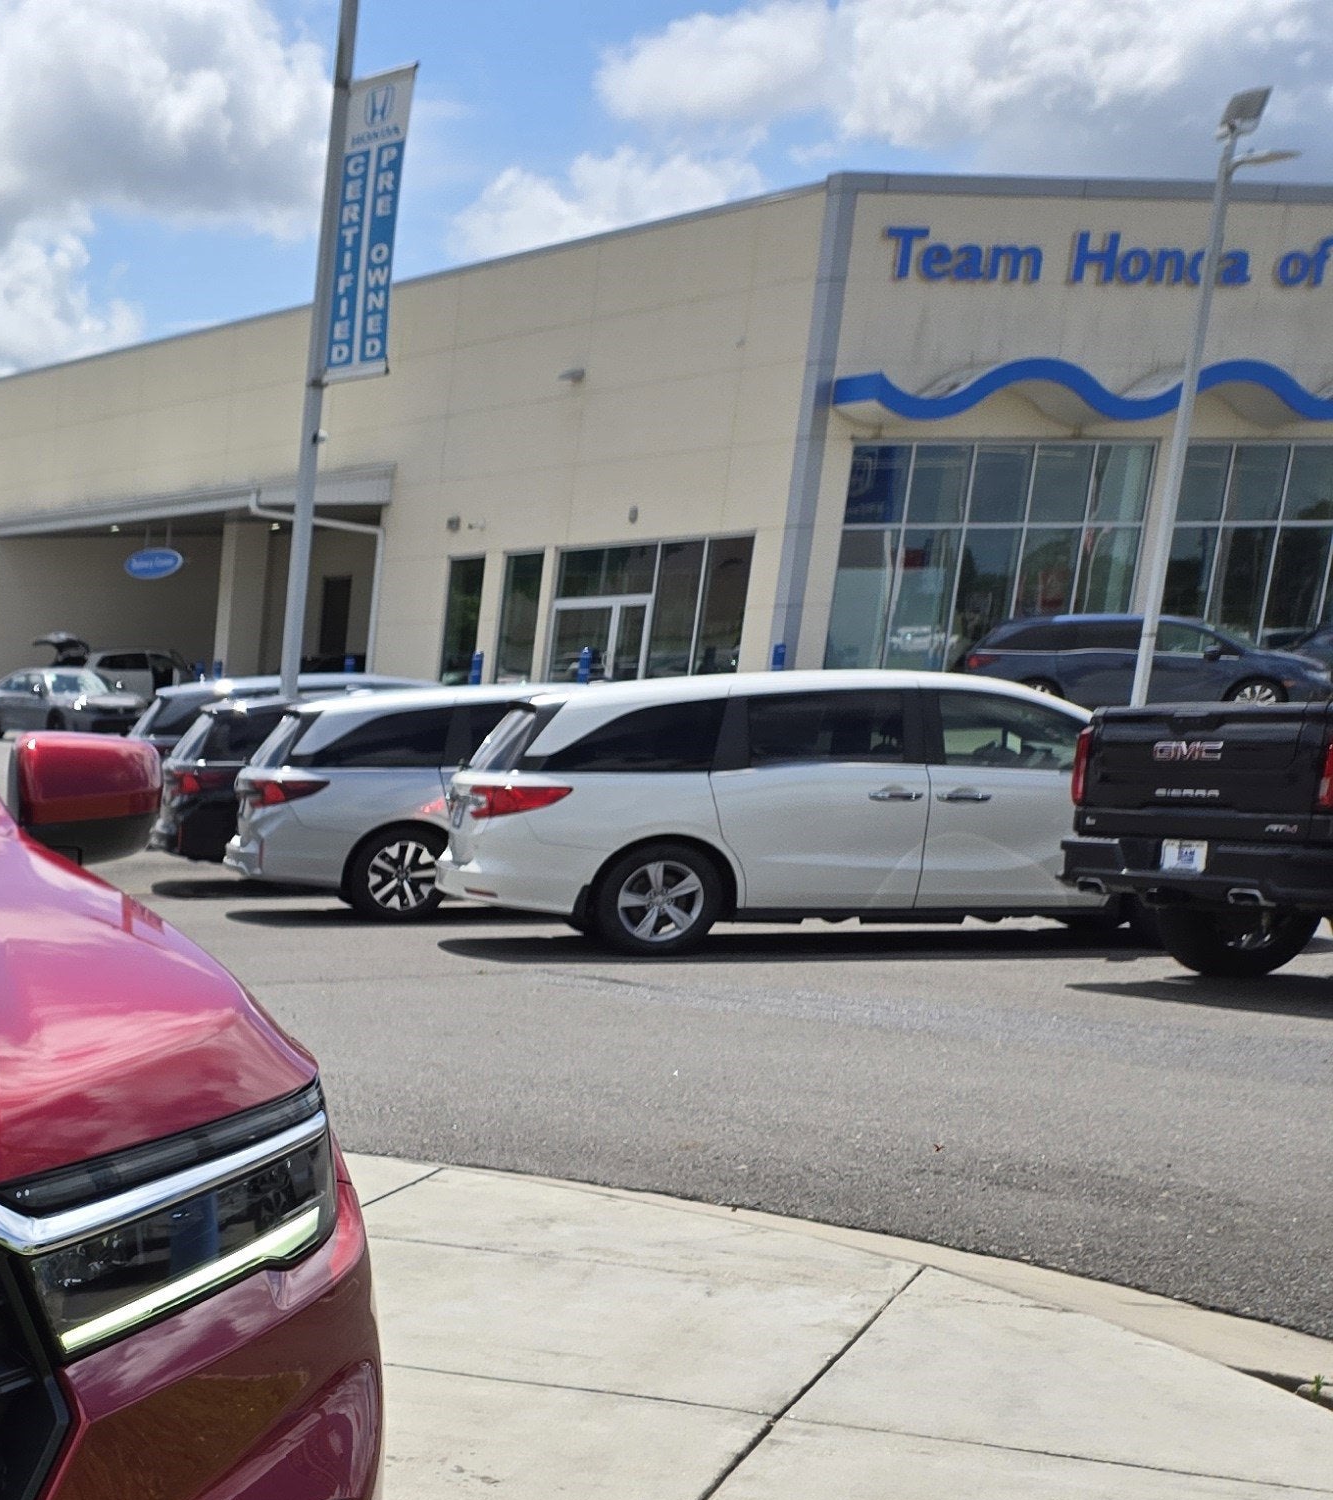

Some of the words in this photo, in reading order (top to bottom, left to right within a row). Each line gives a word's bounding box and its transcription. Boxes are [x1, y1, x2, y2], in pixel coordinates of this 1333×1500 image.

[375, 146, 397, 217] PRE
[330, 154, 367, 364] CERTIFIED
[885, 226, 1043, 283] Team
[364, 243, 389, 358] OWNED
[1152, 740, 1225, 762] GMC
